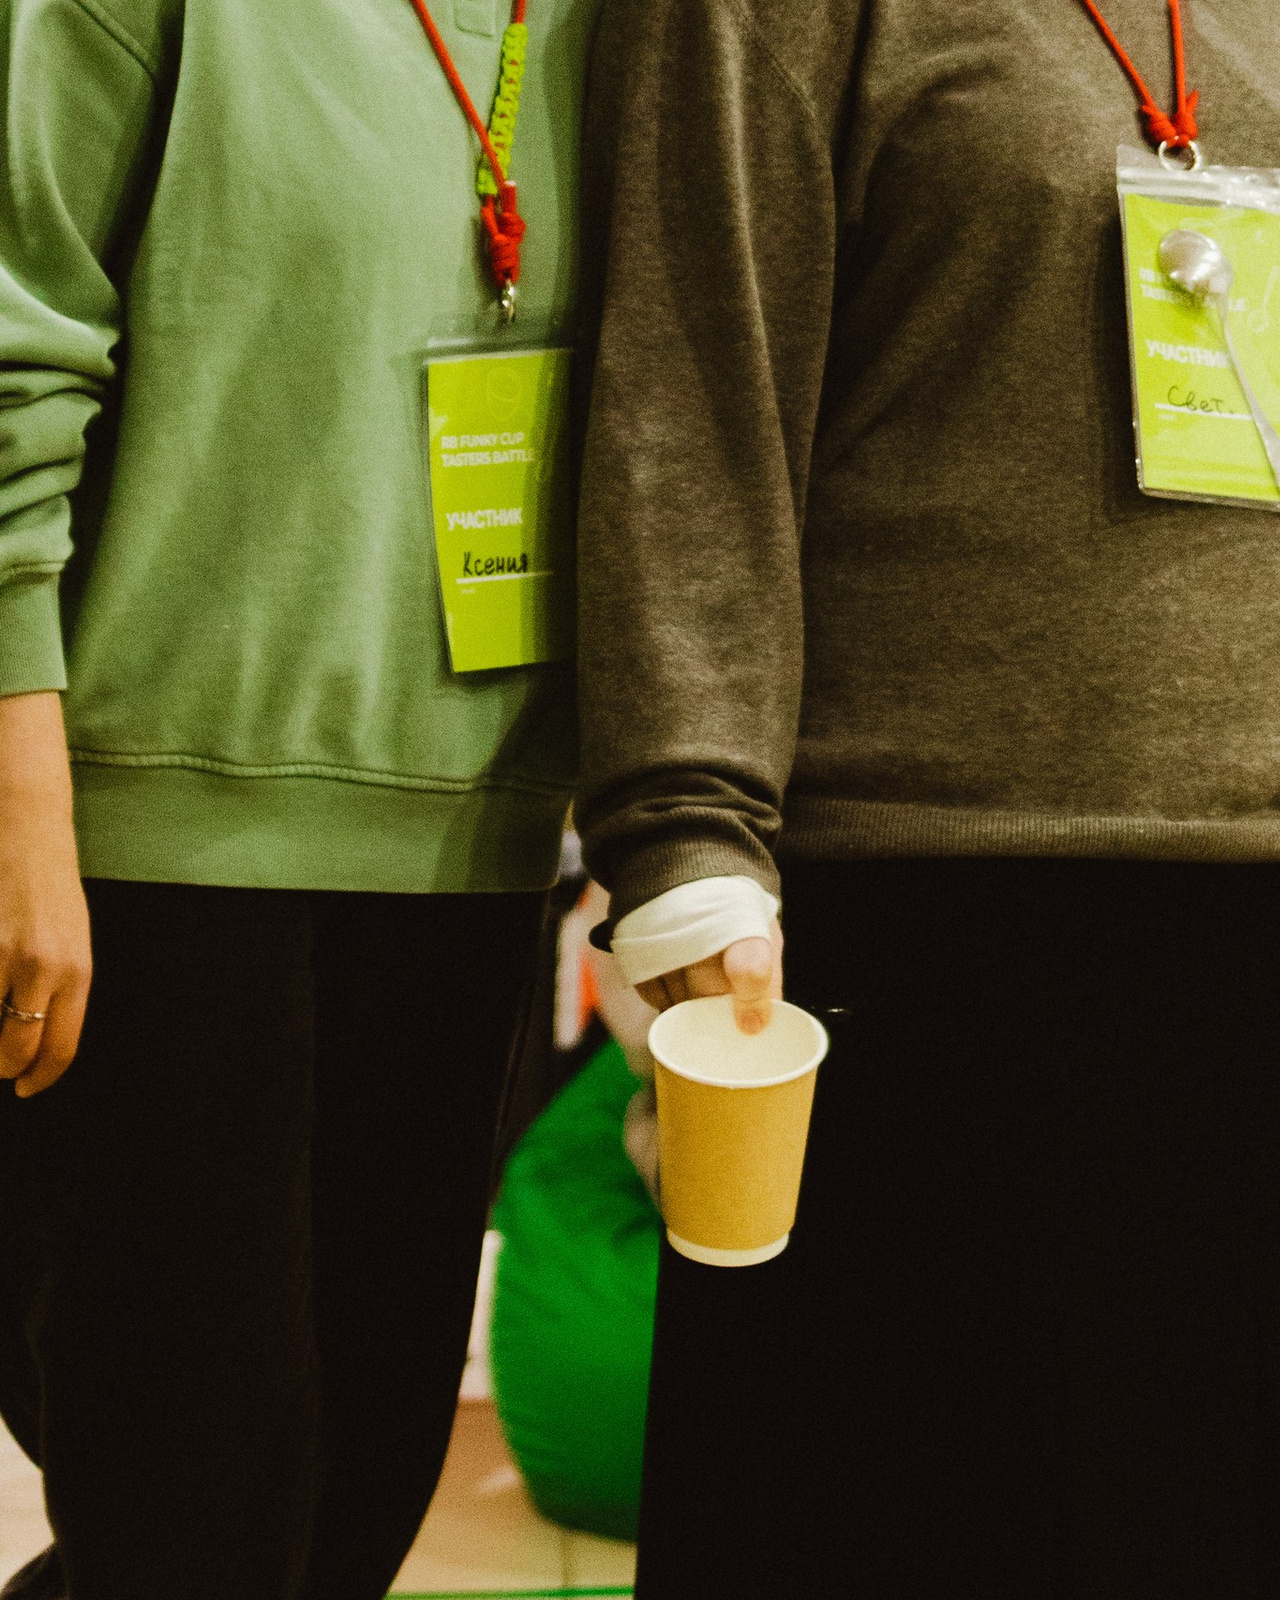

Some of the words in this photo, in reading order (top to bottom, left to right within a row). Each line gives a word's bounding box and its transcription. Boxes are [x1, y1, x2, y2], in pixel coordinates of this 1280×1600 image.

[460, 434, 498, 448] FUNKY
[500, 432, 525, 445] CUP
[441, 451, 492, 467] TASTERS
[493, 449, 534, 464] BATTLE
[445, 508, 523, 531] УЧАСТНИК
[463, 551, 528, 577] Ксения
